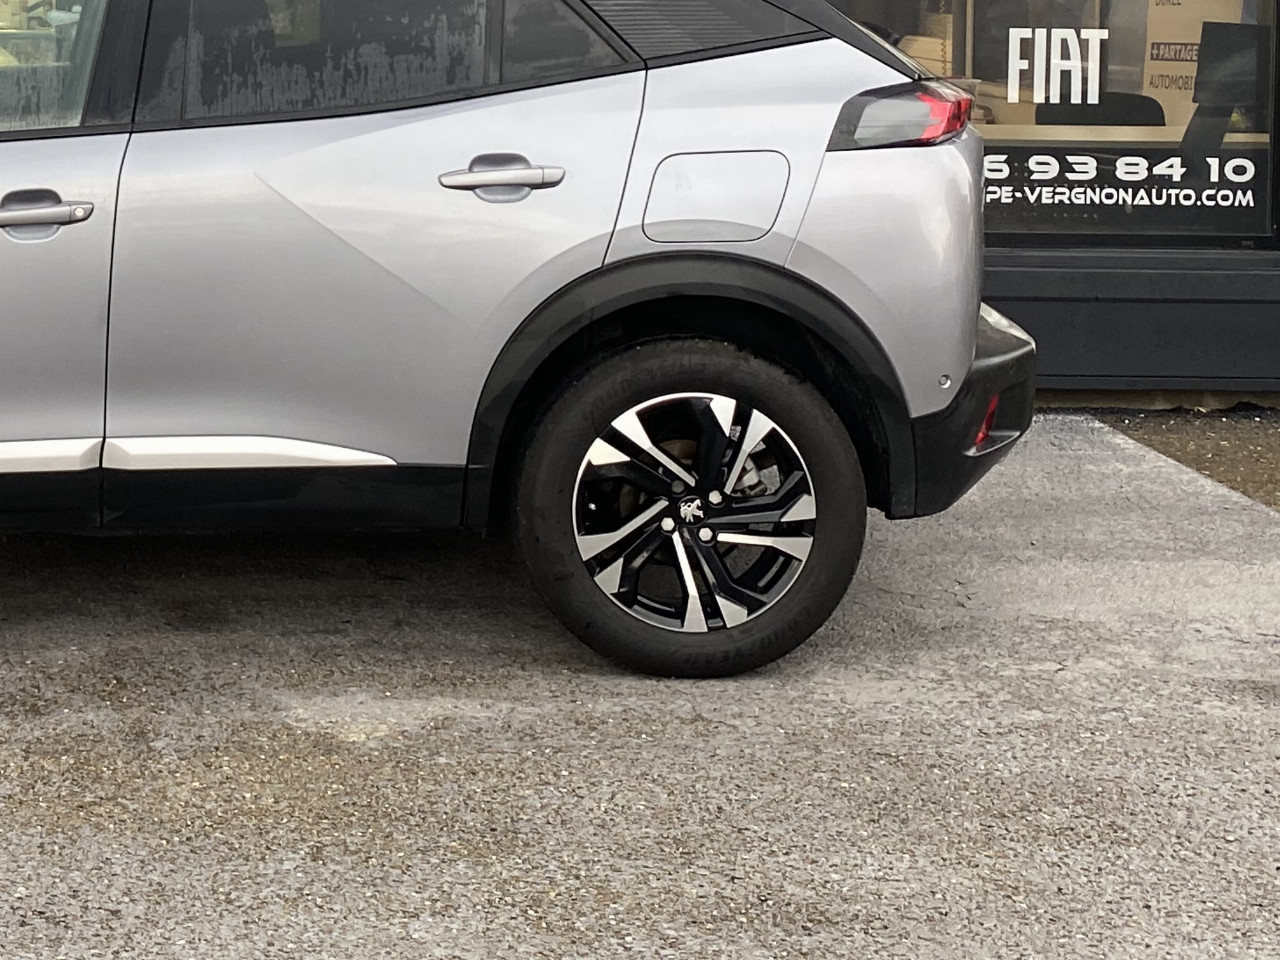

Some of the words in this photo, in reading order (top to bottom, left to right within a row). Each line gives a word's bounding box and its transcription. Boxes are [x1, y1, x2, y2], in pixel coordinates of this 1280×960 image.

[1007, 27, 1109, 105] FIAT
[1149, 74, 1194, 91] AUTOMOBI
[983, 154, 1010, 179] 6
[1028, 155, 1098, 180] 93
[1115, 156, 1187, 182] 84
[1206, 157, 1255, 183] 10
[984, 186, 1255, 208] PE-VERGNONAUTO.COM
